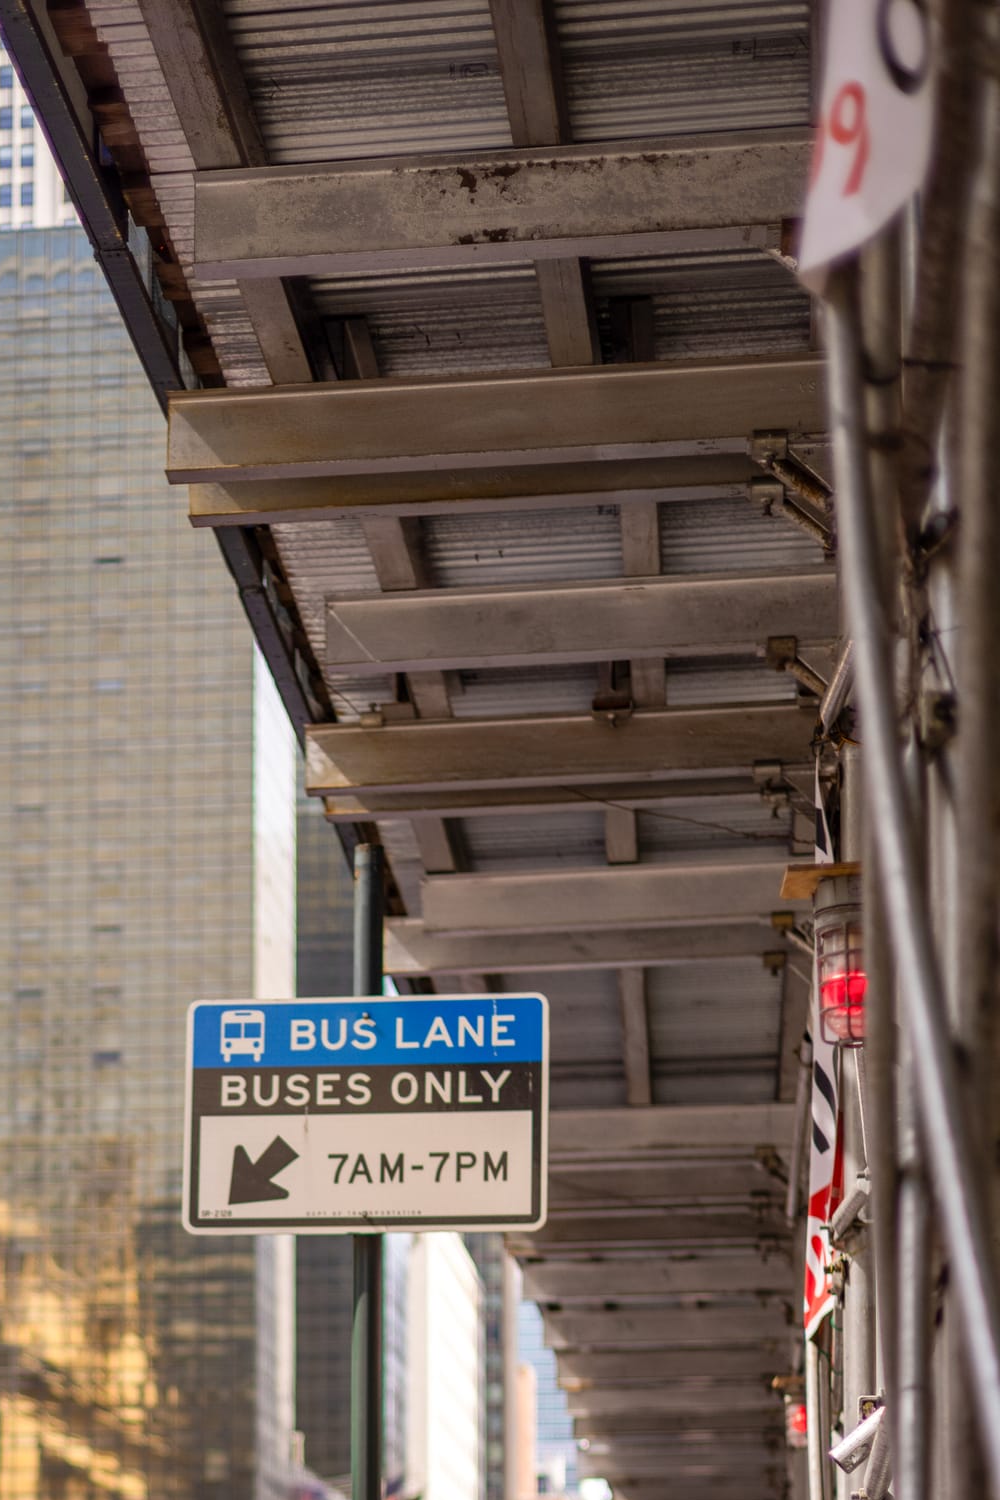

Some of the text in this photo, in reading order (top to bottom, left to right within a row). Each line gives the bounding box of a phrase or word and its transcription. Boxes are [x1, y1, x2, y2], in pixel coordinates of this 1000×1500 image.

[290, 1014, 517, 1051] BUS LANE
[220, 1069, 512, 1107] BUSES ONLY
[328, 1150, 509, 1184] 7AM-7PM
[346, 1208, 423, 1216] TRASPORTATION
